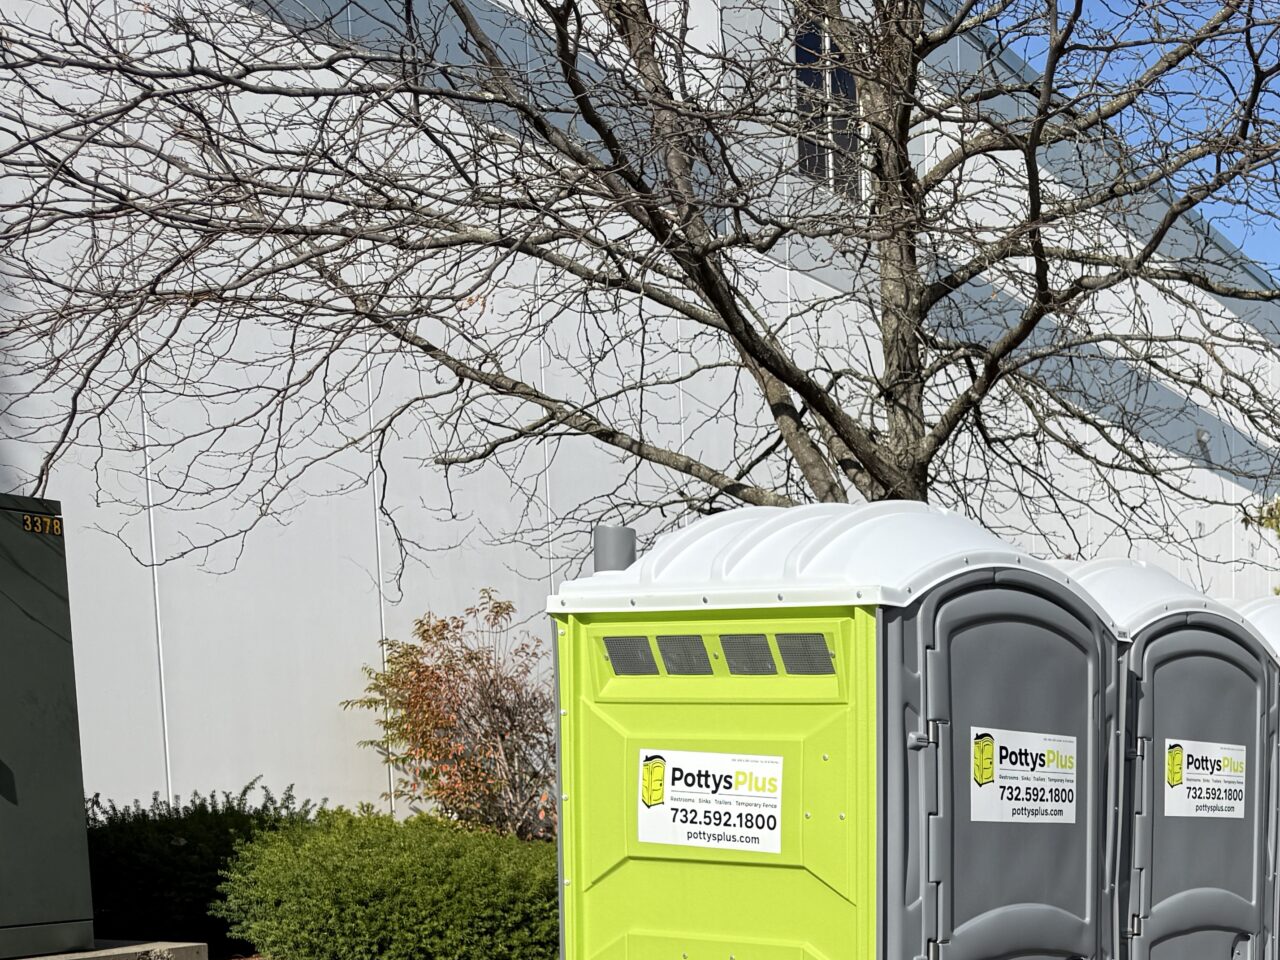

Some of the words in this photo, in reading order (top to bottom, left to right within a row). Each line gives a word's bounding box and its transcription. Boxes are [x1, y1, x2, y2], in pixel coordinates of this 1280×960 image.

[23, 514, 61, 535] 3378
[999, 745, 1074, 772] PottysPlus
[1187, 754, 1244, 775] PottysPlus
[671, 767, 777, 794] PottysPlus
[999, 786, 1074, 803] 732.592.1800
[1186, 787, 1243, 801] 732.592.1800
[735, 800, 762, 808] Temporary
[1012, 806, 1063, 817] pottysplus.com
[1195, 804, 1235, 813] pottysplus.com
[670, 808, 777, 831] 732.592.1800
[687, 830, 760, 844] pottysplus.com
